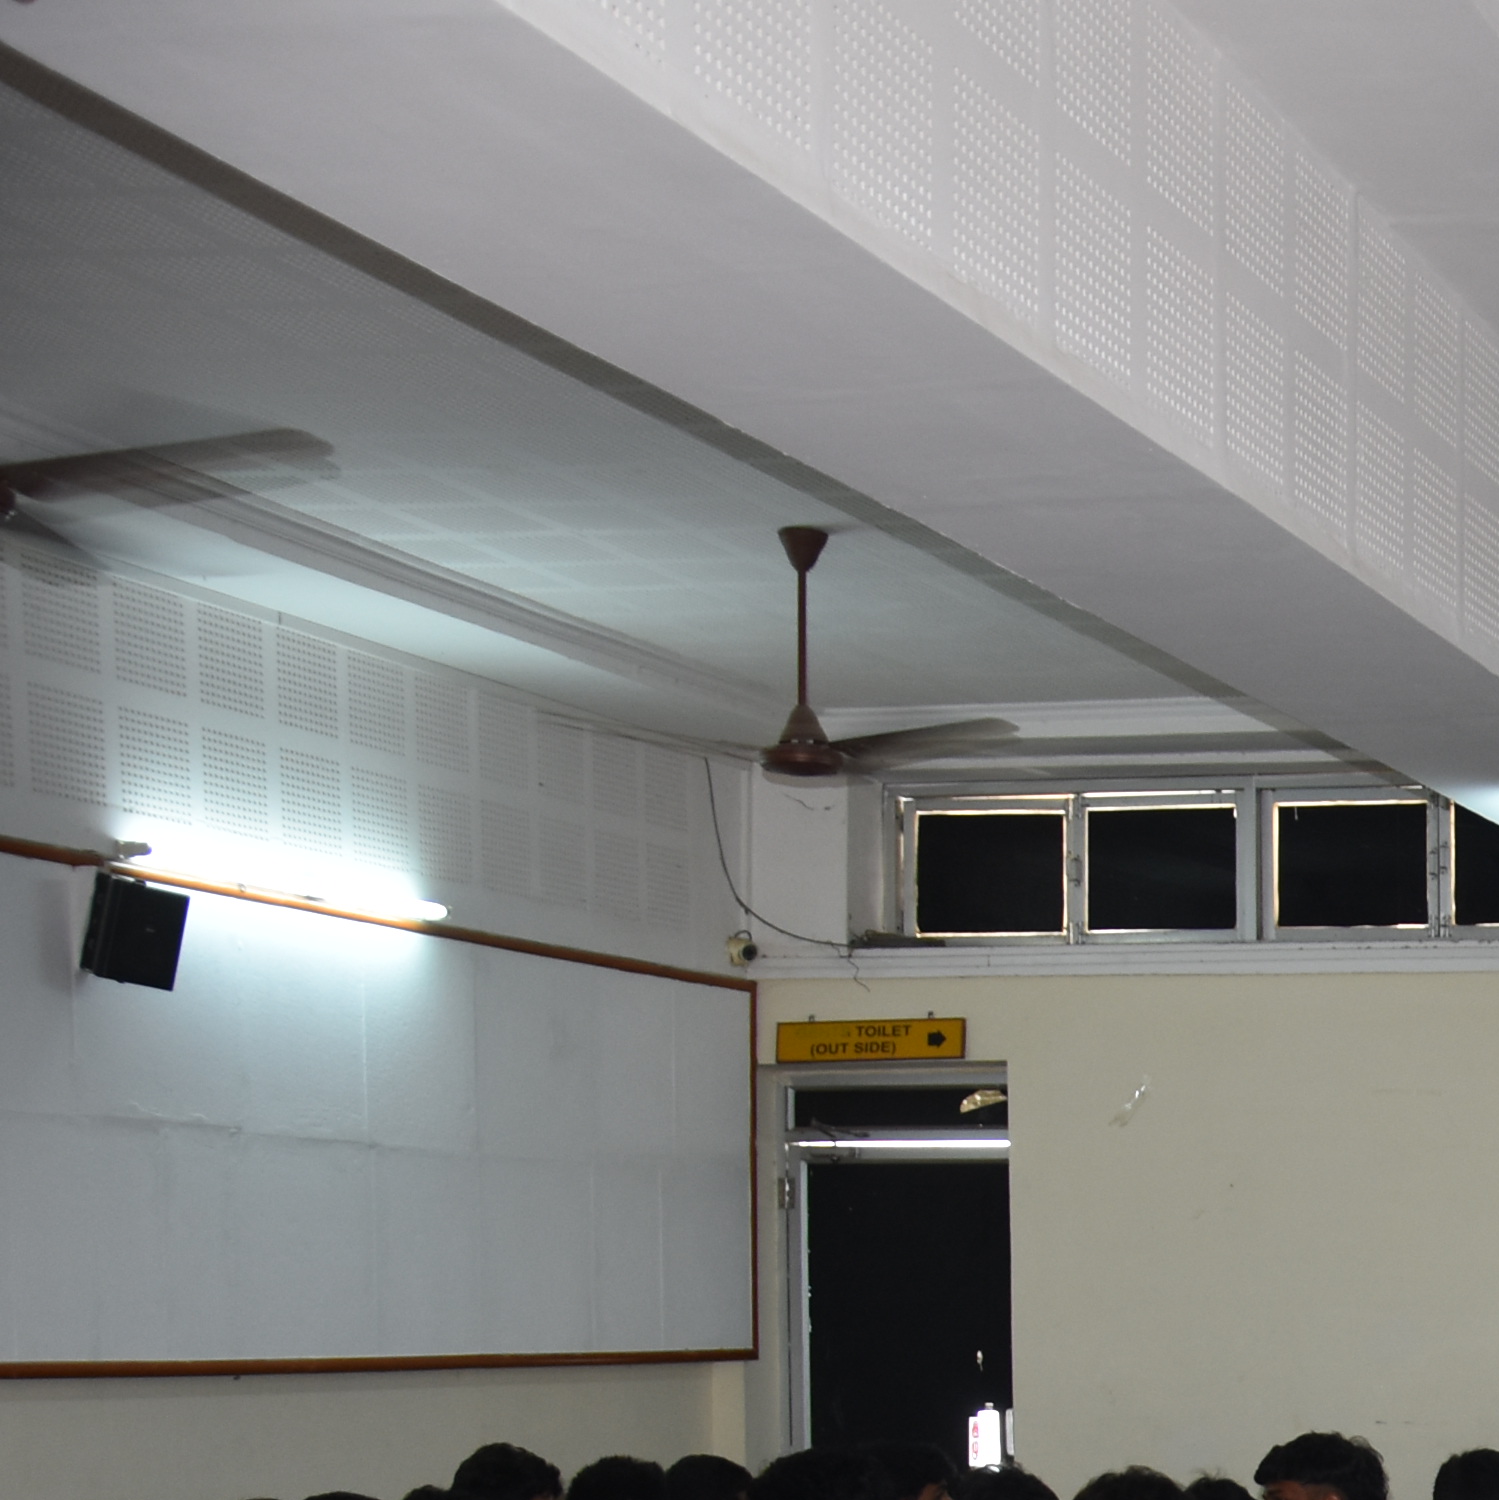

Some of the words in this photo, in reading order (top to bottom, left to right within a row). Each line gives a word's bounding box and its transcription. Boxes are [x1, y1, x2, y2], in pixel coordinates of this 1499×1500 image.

[856, 1024, 913, 1038] TOILET
[810, 1043, 848, 1057] (OUT
[854, 1040, 897, 1056] SIDE)
